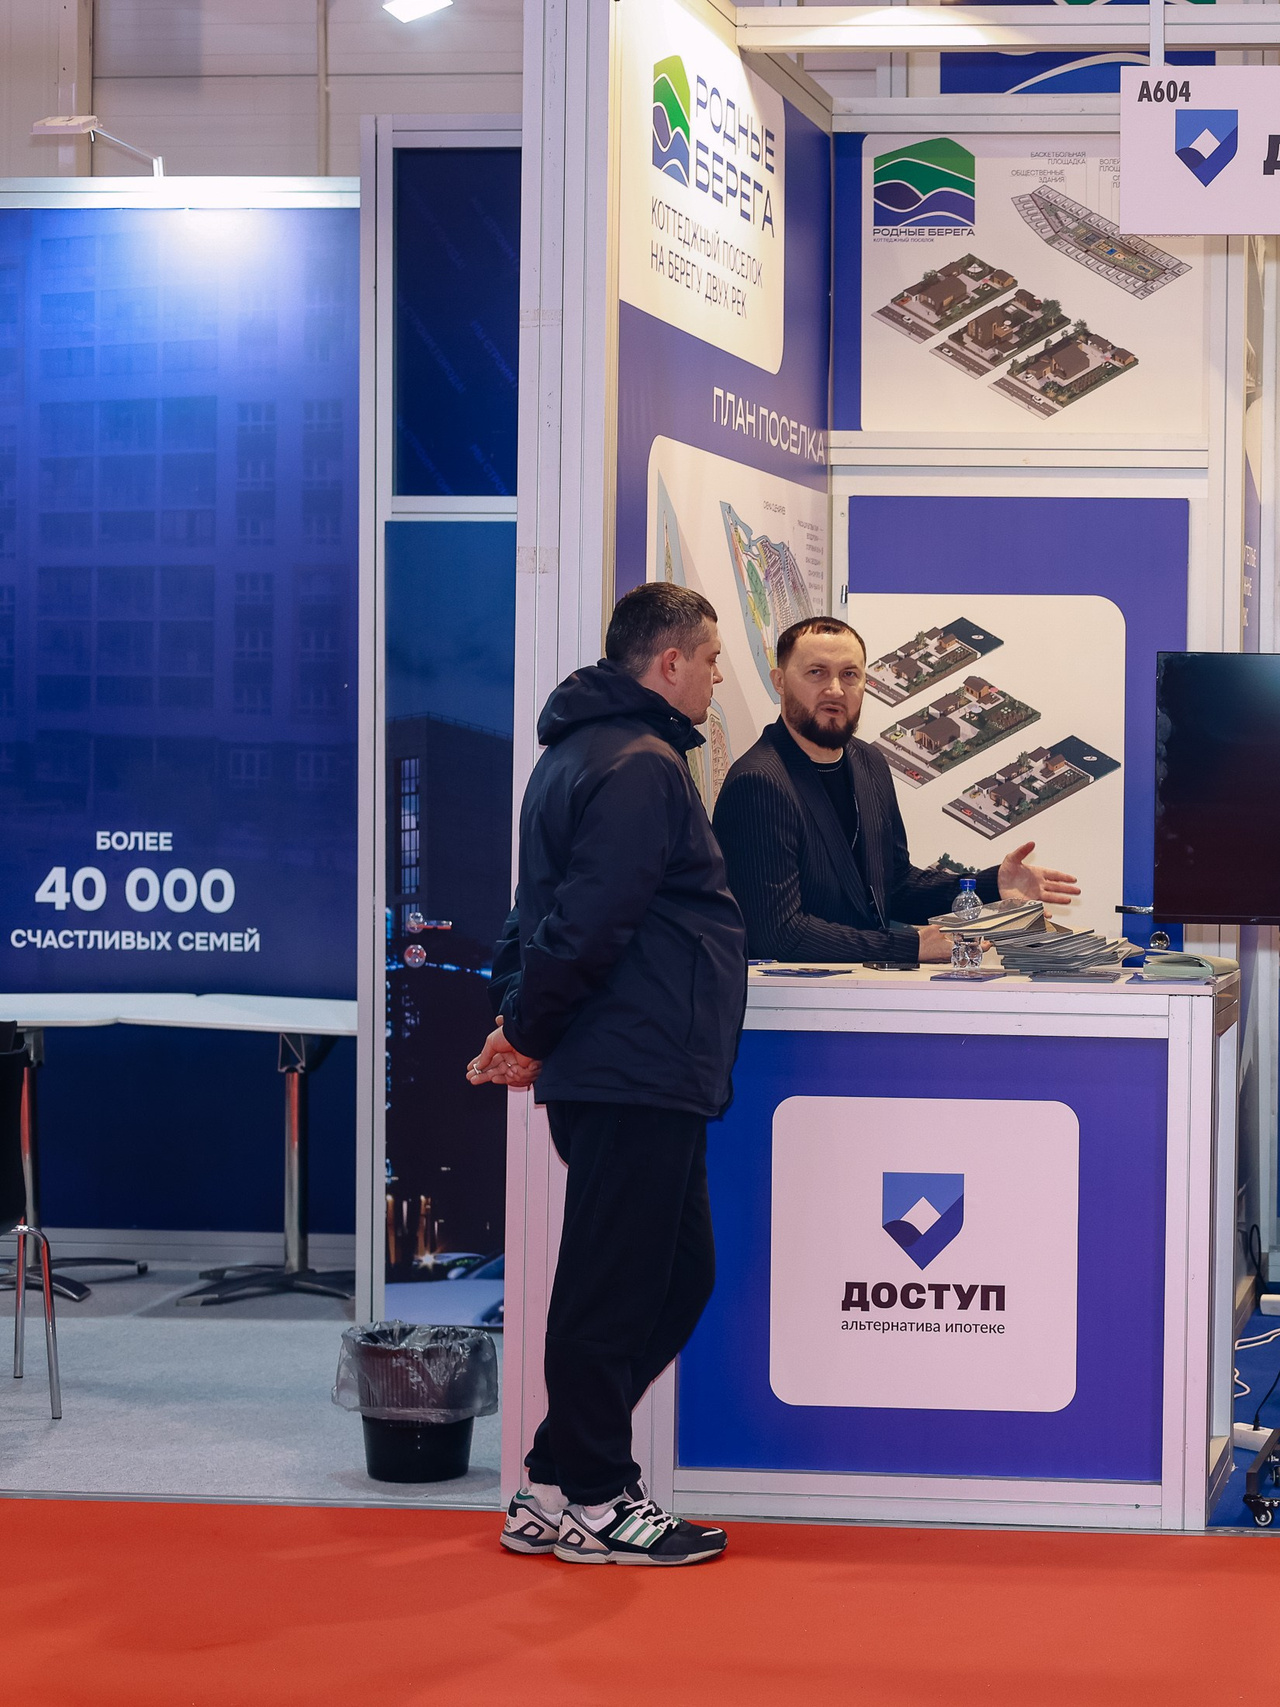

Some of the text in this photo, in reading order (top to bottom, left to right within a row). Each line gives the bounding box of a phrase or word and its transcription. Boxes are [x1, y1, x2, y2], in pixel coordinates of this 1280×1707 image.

[696, 74, 774, 174] РОДНЫЕ
[696, 140, 774, 238] БЕРЕГА
[652, 196, 762, 288] КОТТЕДЖНЫЙ ПОСЕЛОК
[872, 228, 975, 237] РОДНЫЕ БЕРЕГА
[651, 240, 746, 319] НА БЕРЕГУ ДВУХ РЕК
[713, 386, 826, 465] ПЛАН ПОСЕЛКА
[96, 831, 173, 851] БОЛЕЕ
[34, 866, 236, 914] 40 000
[10, 928, 260, 952] СЧАСТЛИВЫХ СЕМЕЙ
[841, 1282, 1006, 1312] ДОСТУП
[841, 1320, 1005, 1334] альтернатива ипотеке
